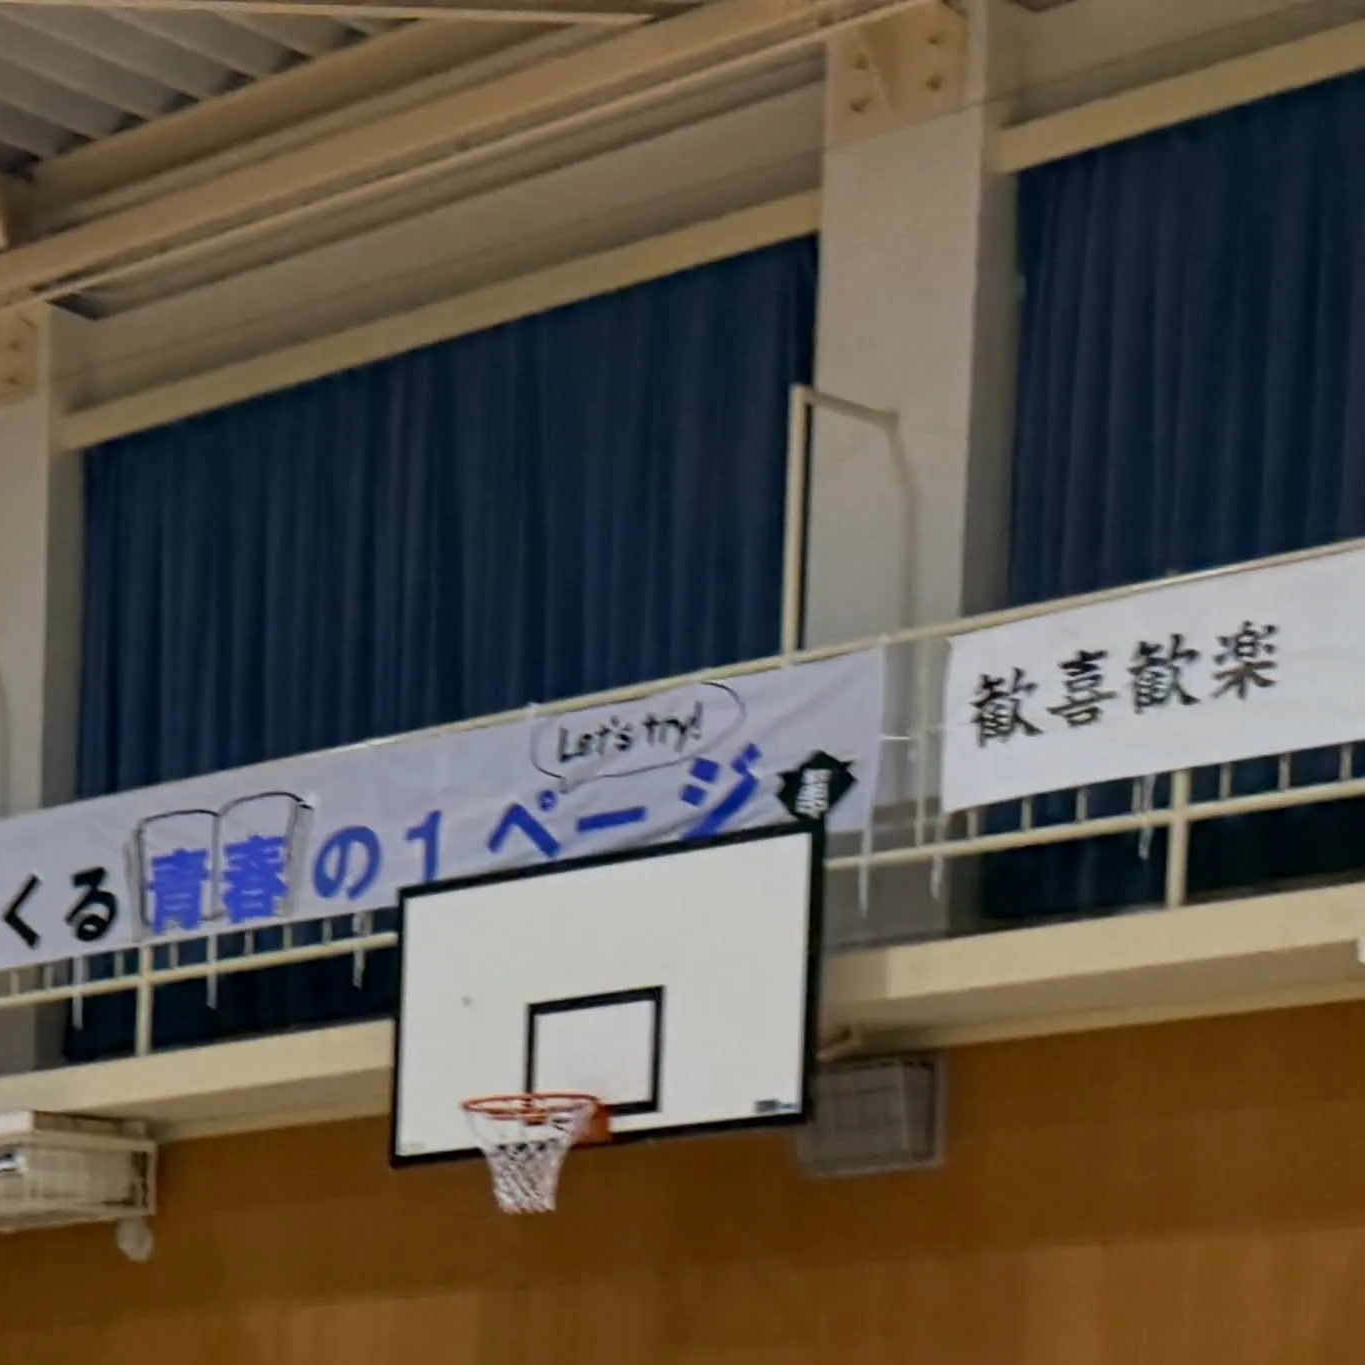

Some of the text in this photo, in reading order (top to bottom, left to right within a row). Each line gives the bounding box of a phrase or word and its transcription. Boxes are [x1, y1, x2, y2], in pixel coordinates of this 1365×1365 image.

[968, 619, 1280, 748] 歓喜歓楽
[558, 701, 704, 763] Let's try!
